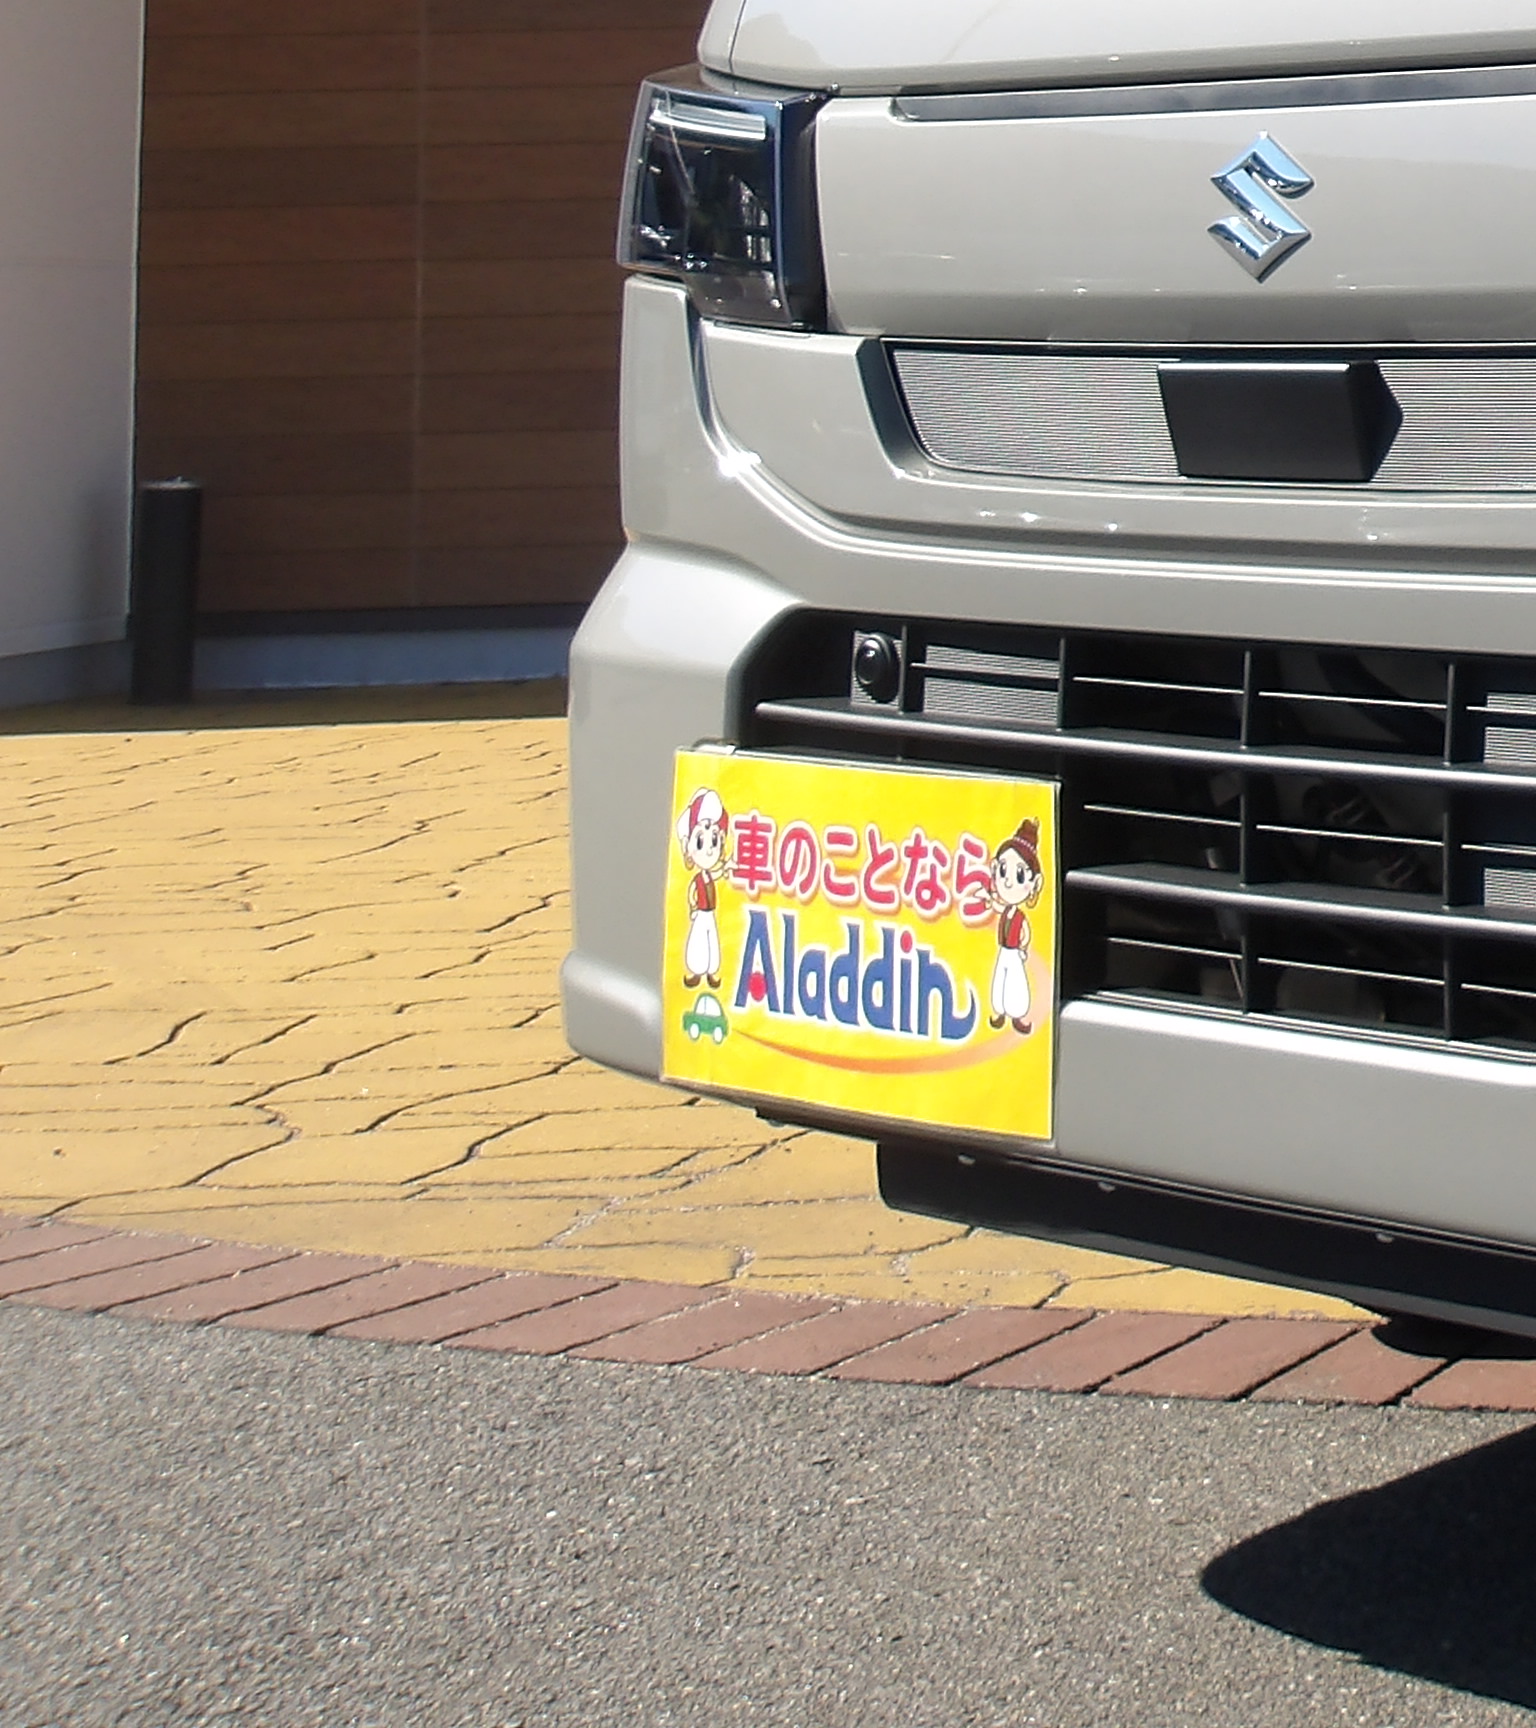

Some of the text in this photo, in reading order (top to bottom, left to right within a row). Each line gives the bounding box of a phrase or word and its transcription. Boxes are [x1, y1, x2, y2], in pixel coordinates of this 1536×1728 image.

[732, 814, 992, 917] 車のことなら
[734, 909, 977, 1041] Aladdin
